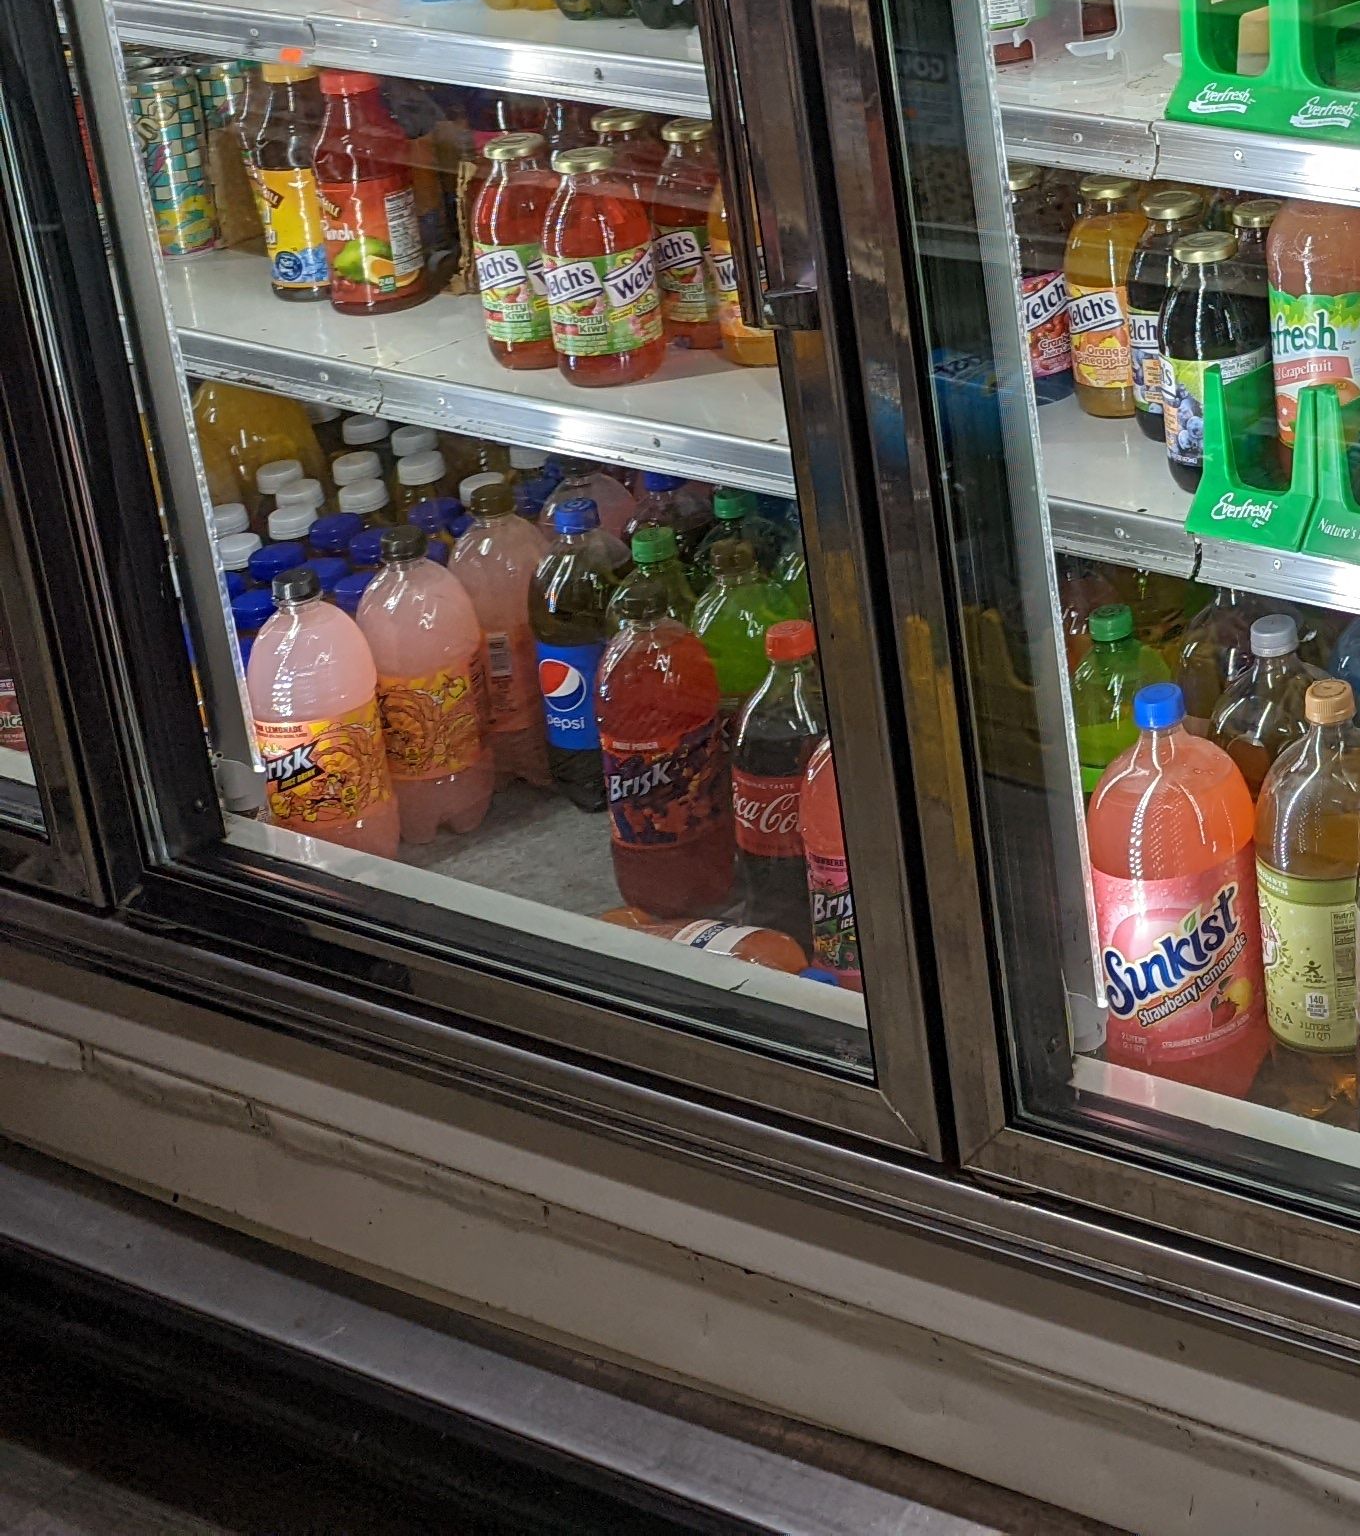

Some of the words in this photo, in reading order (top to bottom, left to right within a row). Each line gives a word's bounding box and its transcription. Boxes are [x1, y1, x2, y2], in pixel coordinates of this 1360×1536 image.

[1211, 492, 1274, 521] Everfresh
[1317, 518, 1356, 541] Nature's
[547, 714, 585, 732] pepsi
[1104, 881, 1240, 1017] Sunkist
[1137, 983, 1196, 1028] Strawberry
[1195, 932, 1248, 997] Lemonade
